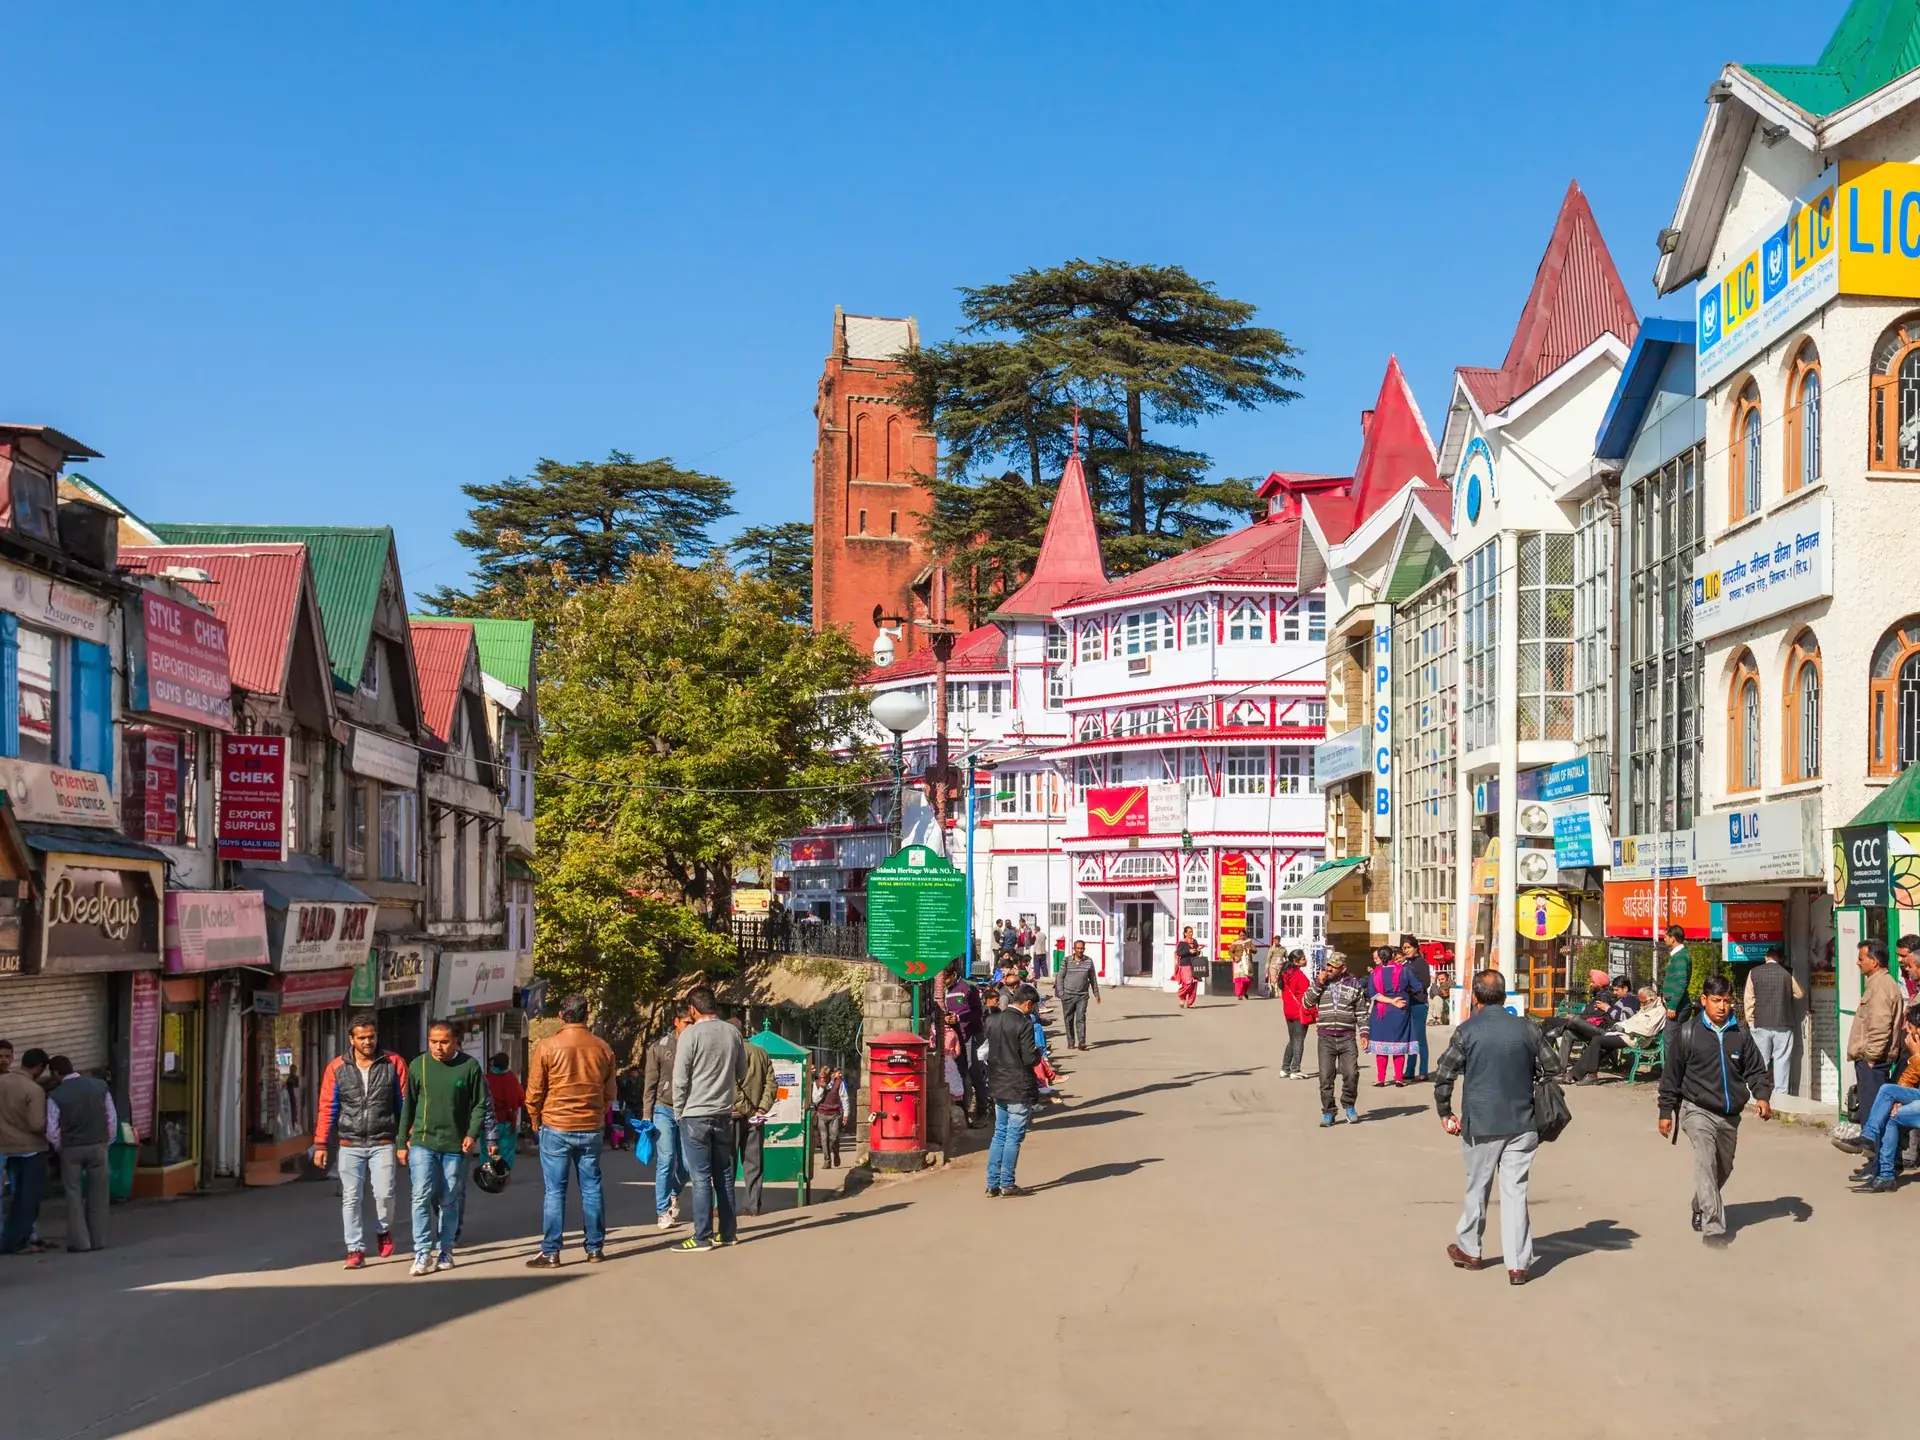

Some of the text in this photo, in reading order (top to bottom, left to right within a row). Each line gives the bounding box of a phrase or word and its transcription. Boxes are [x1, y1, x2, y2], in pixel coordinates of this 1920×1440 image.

[1794, 195, 1831, 271] LIC
[1849, 187, 1920, 259] LIC
[1726, 260, 1755, 326] LIC
[1722, 531, 1820, 587] भारतीय जीवन बीमा निगम
[1705, 574, 1719, 601] LIC
[149, 600, 226, 653] STYLE CHEK
[156, 681, 229, 717] GUYS GALS KIDS
[227, 743, 279, 757] STYLE
[50, 770, 99, 793] Oriental
[229, 771, 275, 785] CHEK
[1561, 768, 1567, 782] OF
[224, 820, 276, 831] SURPLUS
[228, 809, 273, 820] EXPORT
[1743, 812, 1759, 840] LIC
[219, 839, 241, 847] GUYS
[241, 840, 261, 848] GALS
[1623, 841, 1635, 864] LIC
[1852, 837, 1882, 868] CCC
[897, 867, 922, 875] Heritage
[48, 876, 139, 940] Beekays
[1672, 886, 1688, 918] बैंक
[202, 903, 237, 928] Kodak
[1759, 932, 1768, 941] एम
[0, 956, 20, 971] LACE
